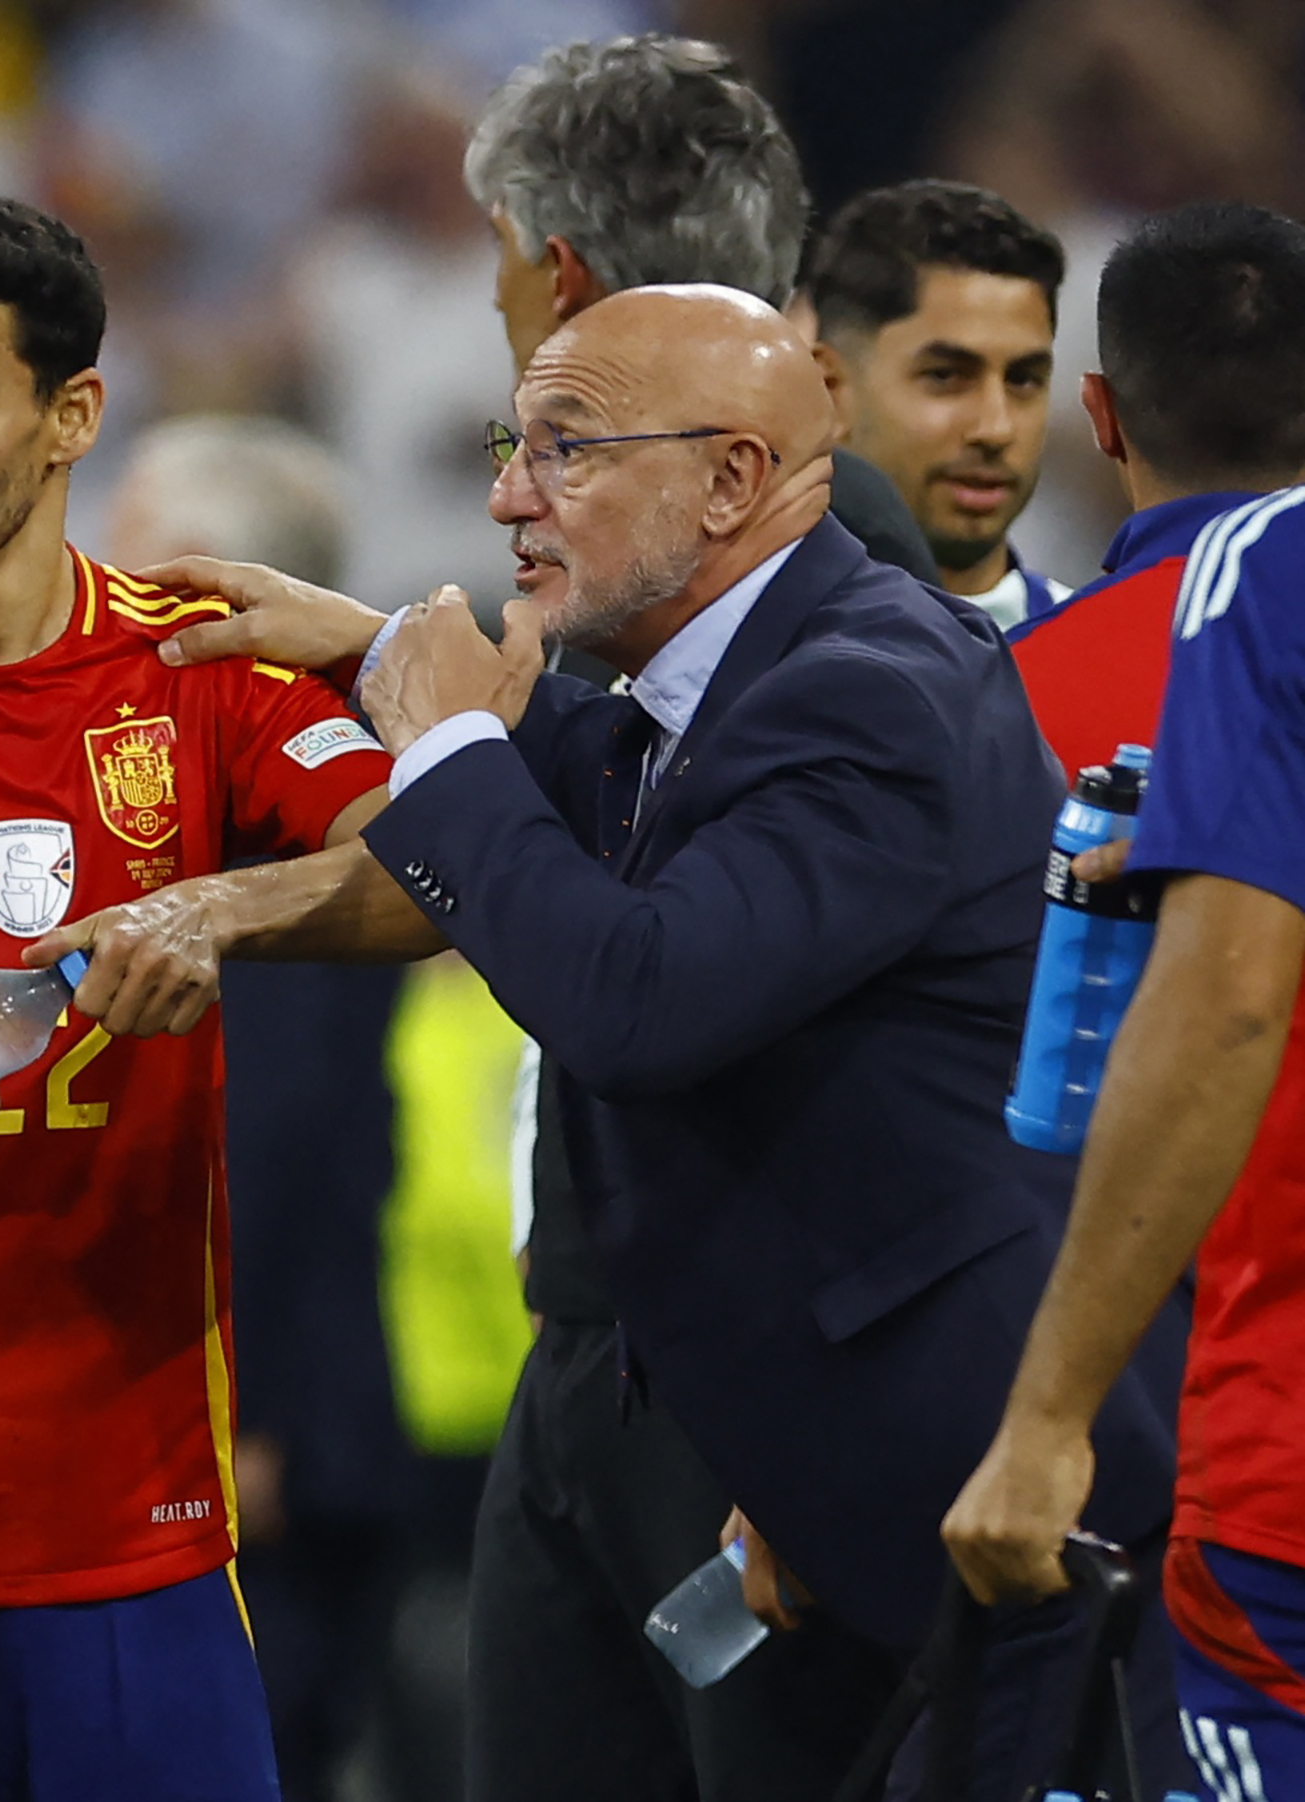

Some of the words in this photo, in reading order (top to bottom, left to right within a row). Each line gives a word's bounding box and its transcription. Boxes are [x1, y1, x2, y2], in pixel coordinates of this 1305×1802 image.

[287, 730, 316, 752] UEFA
[33, 824, 65, 834] LEAGUE
[151, 1499, 210, 1523] HEAT.RDY
